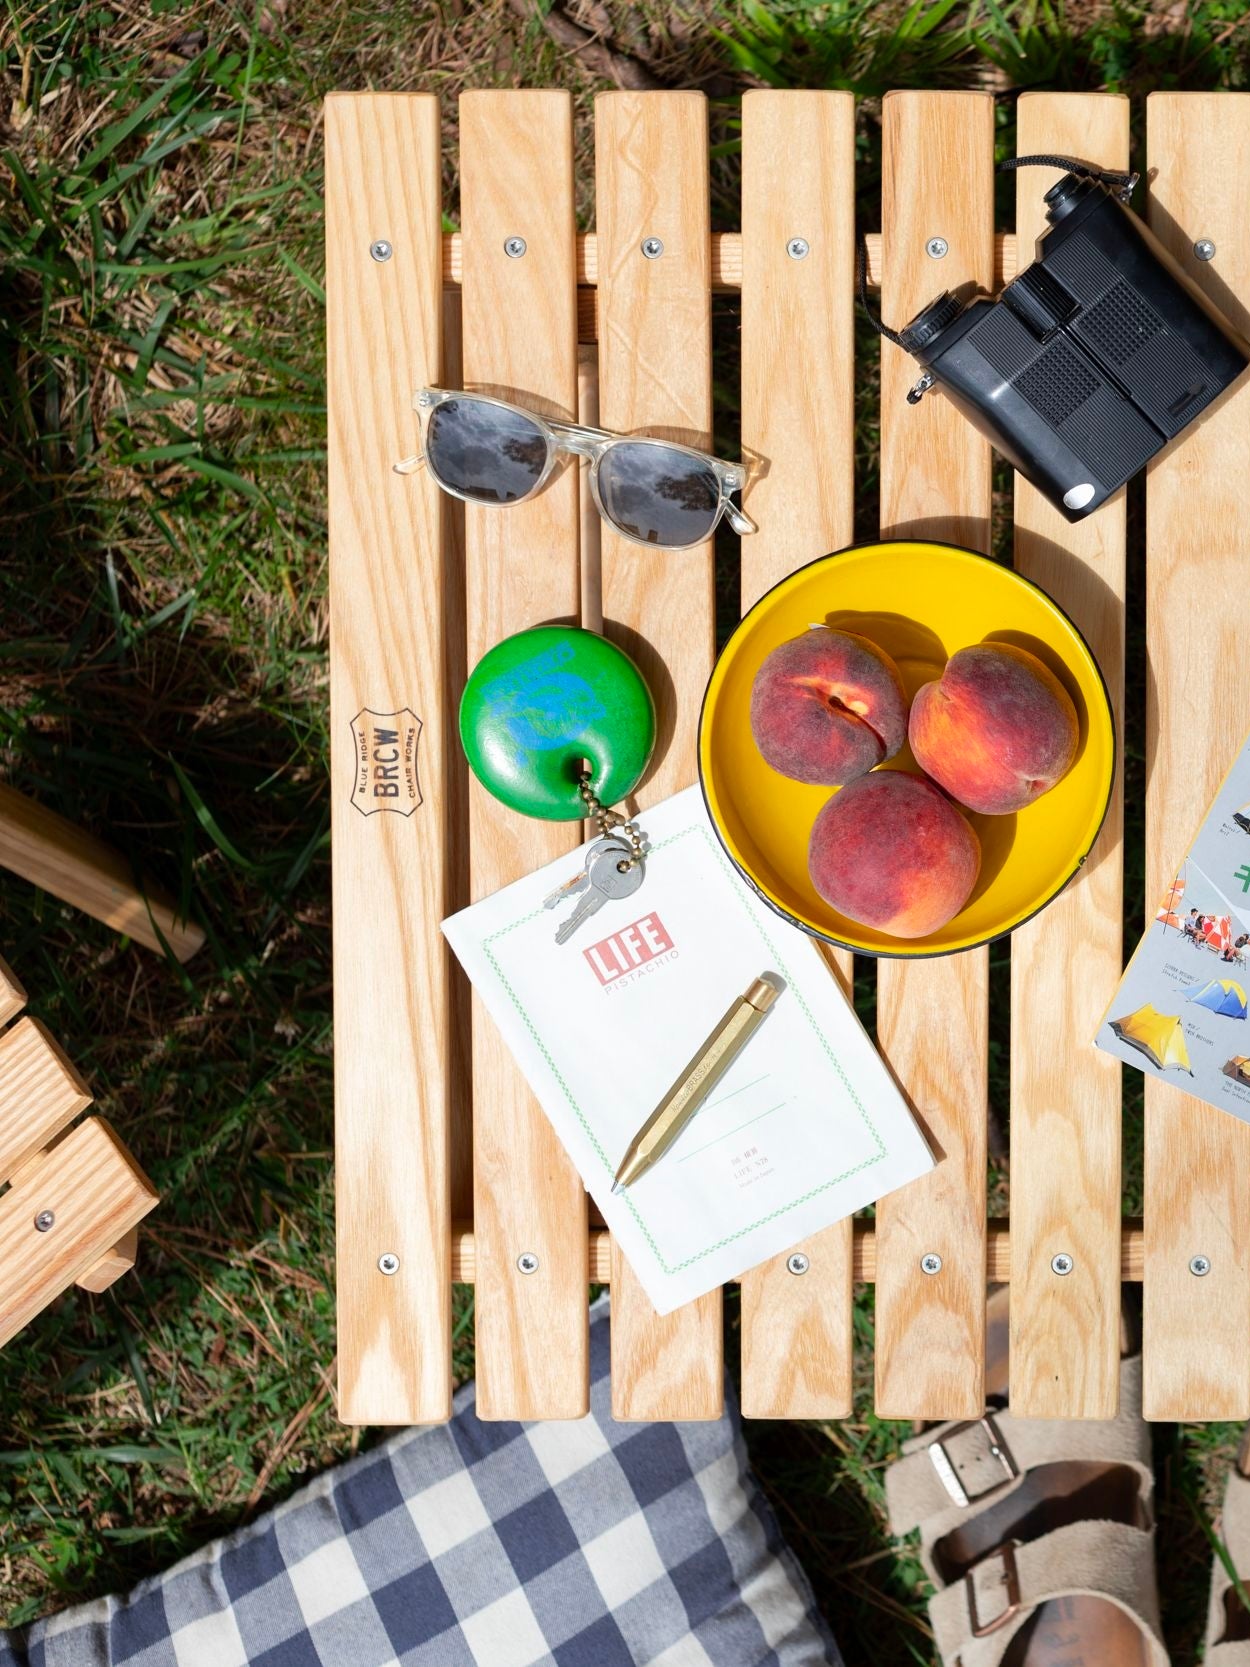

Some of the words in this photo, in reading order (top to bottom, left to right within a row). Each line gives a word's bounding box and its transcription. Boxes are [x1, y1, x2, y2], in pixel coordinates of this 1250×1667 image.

[373, 728, 399, 797] BRCW
[405, 728, 415, 762] WORKS
[359, 767, 368, 793] BLUE
[405, 768, 415, 798] CHAIR
[588, 918, 666, 980] LIFE
[604, 949, 679, 995] PISTACHIO
